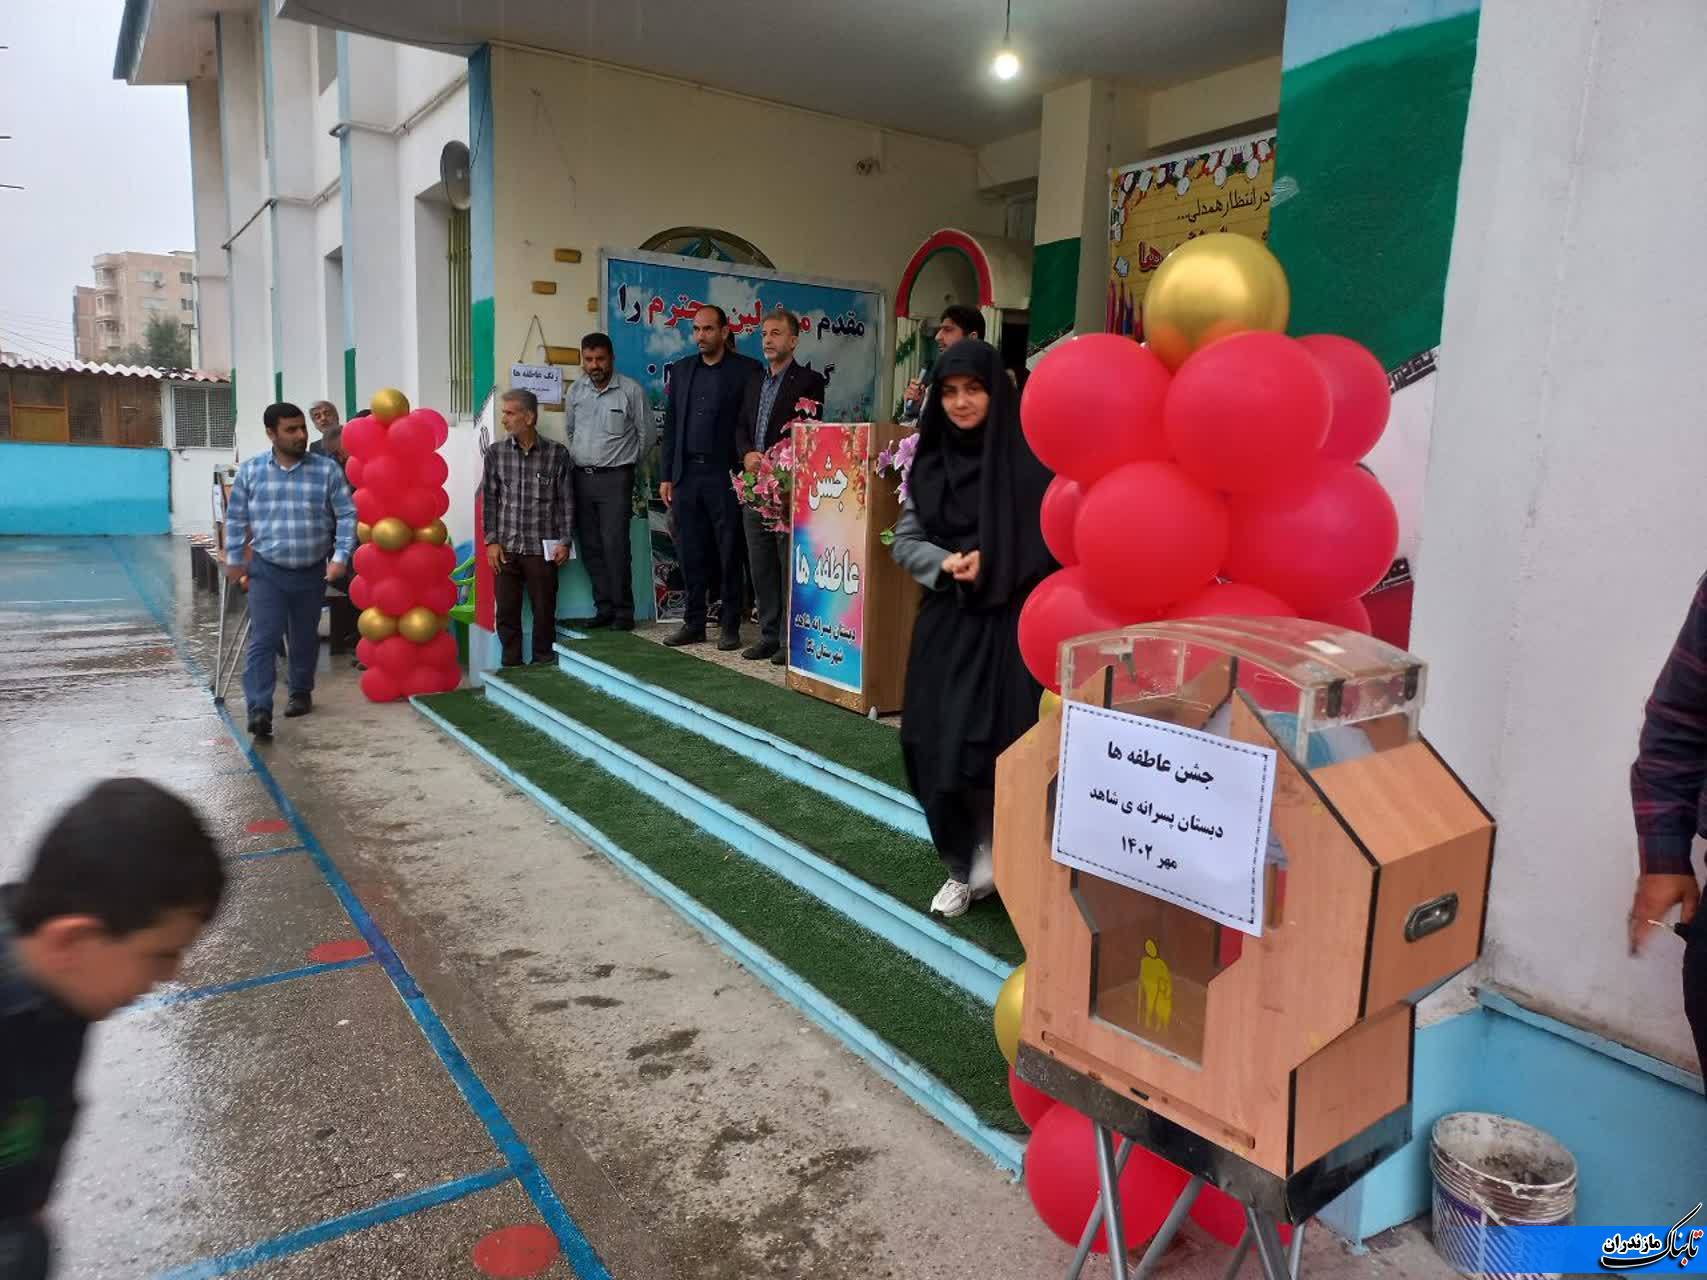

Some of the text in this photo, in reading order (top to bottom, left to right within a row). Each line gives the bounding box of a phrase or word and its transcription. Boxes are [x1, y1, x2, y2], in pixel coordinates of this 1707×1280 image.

[617, 281, 642, 324] را
[647, 294, 705, 329] حترم
[817, 311, 866, 340] مقدم
[512, 367, 521, 377] ها
[808, 455, 849, 512] جشن
[795, 544, 860, 595] عاطفه ها
[1107, 741, 1214, 790] جشن عاطفه ها
[1089, 787, 1224, 841] دبستان پسرانه ی شاهد
[1121, 835, 1178, 870] مهر ۱۴۰۲
